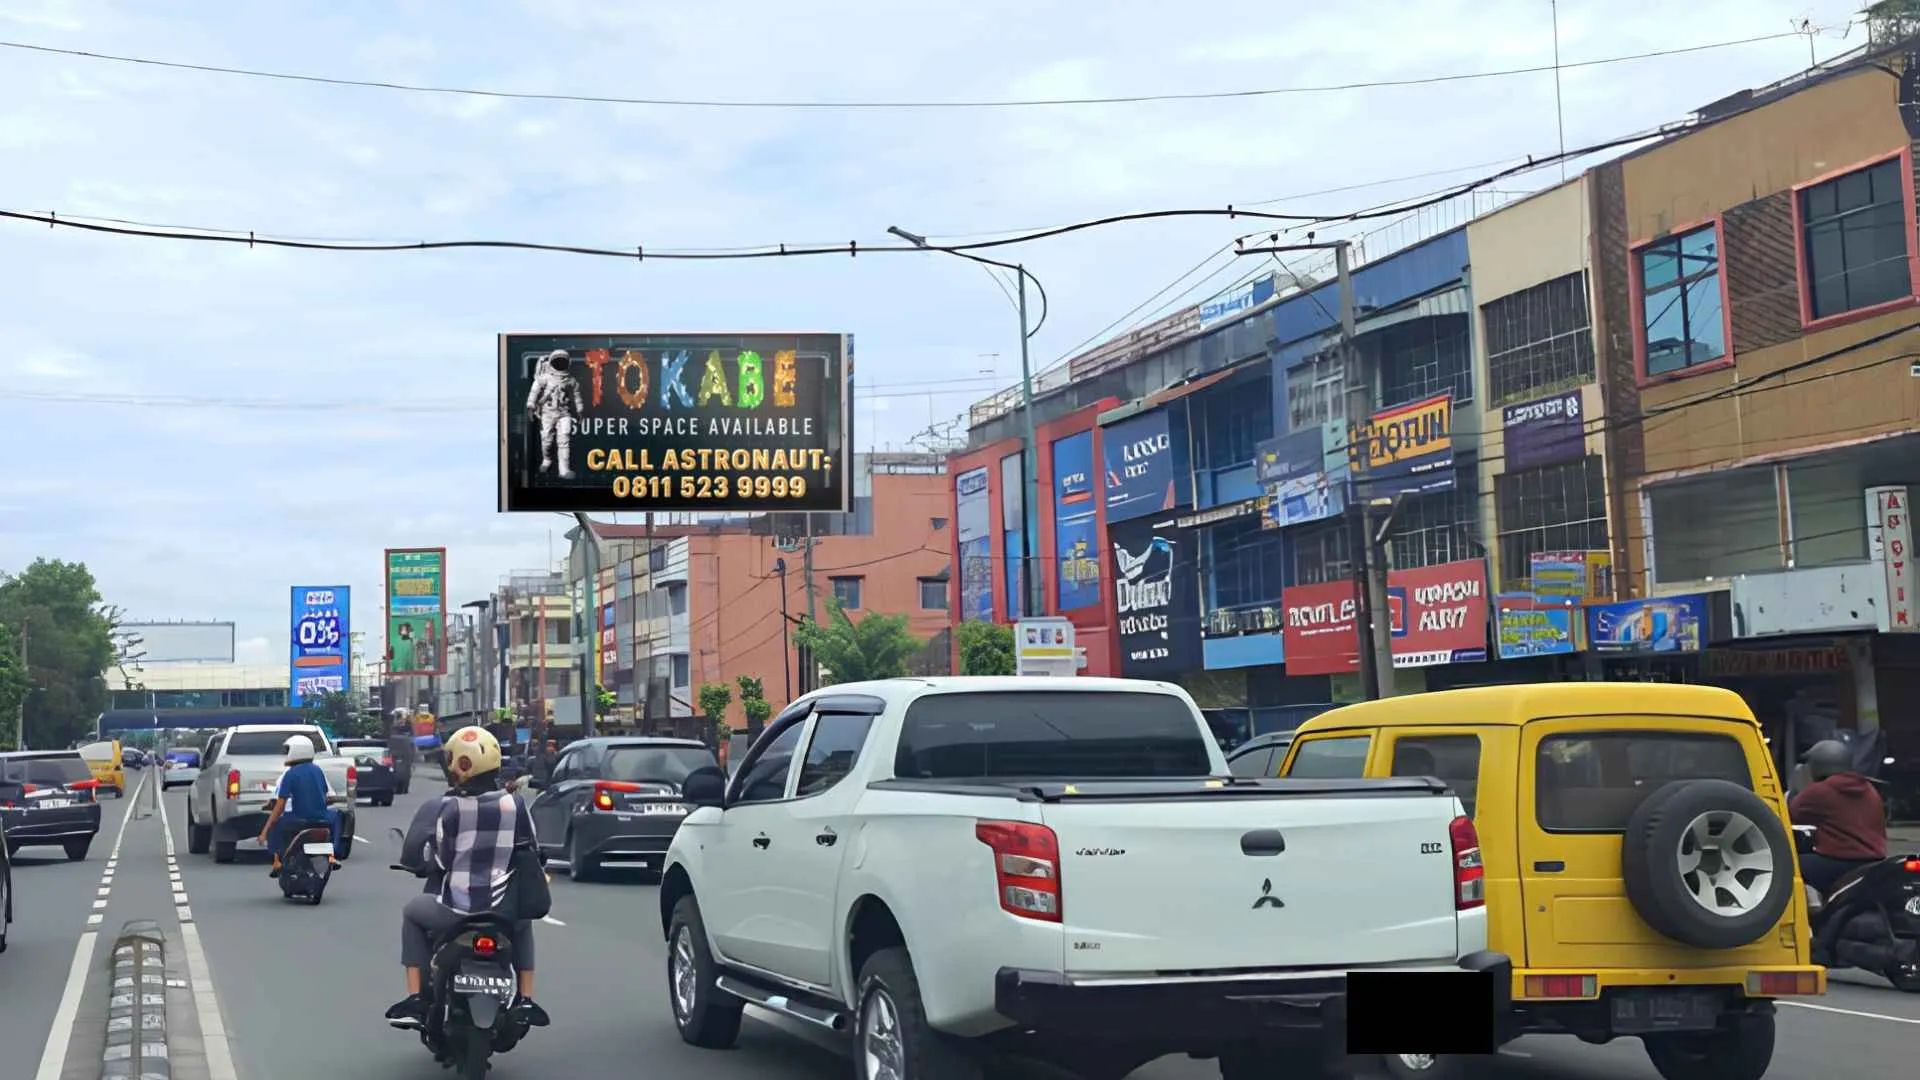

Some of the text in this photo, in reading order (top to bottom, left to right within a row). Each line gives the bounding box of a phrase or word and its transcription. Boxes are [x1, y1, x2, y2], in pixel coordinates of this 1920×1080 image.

[585, 349, 797, 410] TOKABE
[571, 417, 813, 436] SUPER SPACE AVAILABLE
[586, 448, 832, 471] CALL ASTRONAUT:
[613, 475, 807, 498] 0811 523 9999
